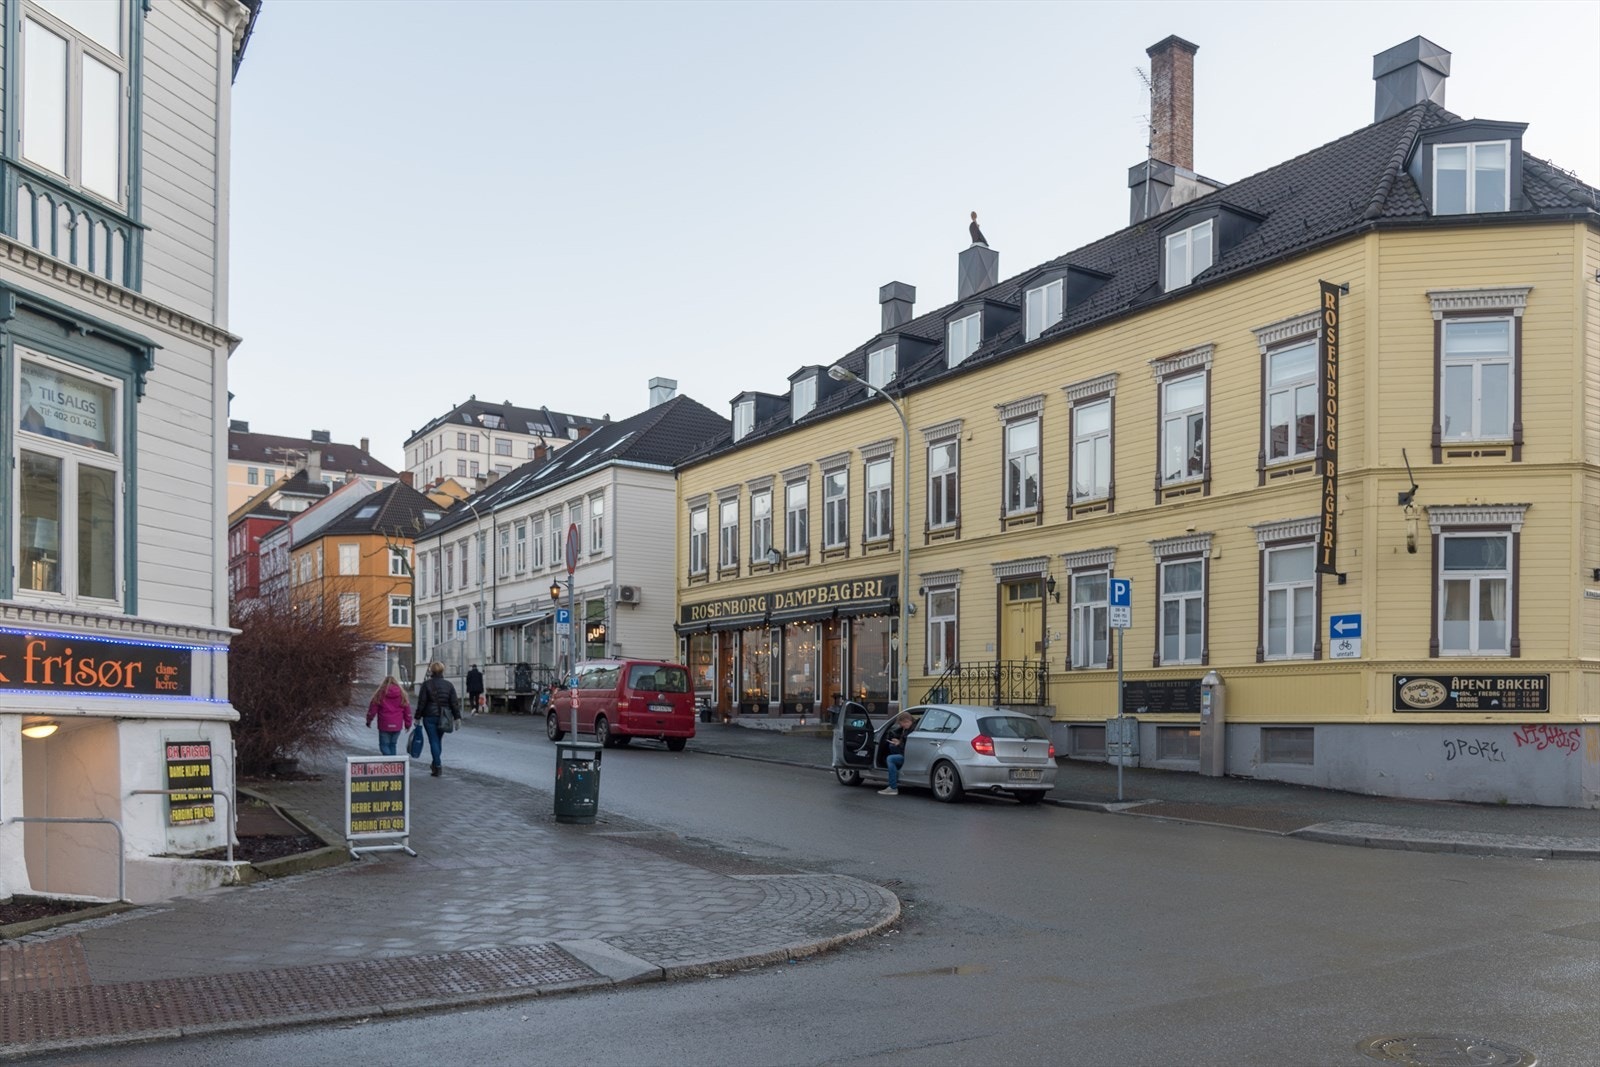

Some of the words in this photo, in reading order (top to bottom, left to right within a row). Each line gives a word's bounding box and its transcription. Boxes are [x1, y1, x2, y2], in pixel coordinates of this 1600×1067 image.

[1325, 292, 1336, 450] ROSENBORG
[57, 392, 96, 415] SALGS
[53, 410, 68, 422] 402
[82, 418, 97, 430] 442
[1323, 460, 1335, 565] BAGERI
[691, 596, 767, 620] ROSENBORG
[775, 579, 883, 610] DAMPBAGERI
[1114, 582, 1126, 603] P
[560, 610, 568, 622] P
[458, 620, 465, 630] P
[587, 624, 606, 642] PUB
[23, 640, 142, 688] frisør
[155, 662, 178, 676] dame
[155, 679, 178, 690] herre
[1451, 676, 1493, 690] ÅPENT
[1497, 679, 1544, 690] BAKERI
[169, 765, 185, 778] DAME
[185, 765, 199, 777] KLIPP
[200, 764, 210, 776] 399
[351, 782, 370, 792] DAME
[371, 781, 389, 791] KLIPP
[390, 780, 402, 791] 399
[172, 809, 193, 821] FARGING
[193, 807, 204, 819] FRA
[351, 803, 371, 813] HERRE
[372, 802, 390, 812] KLIPP
[391, 801, 403, 812] 299
[351, 820, 378, 832] FARGING
[379, 819, 391, 830] FRA
[392, 819, 404, 829] 499
